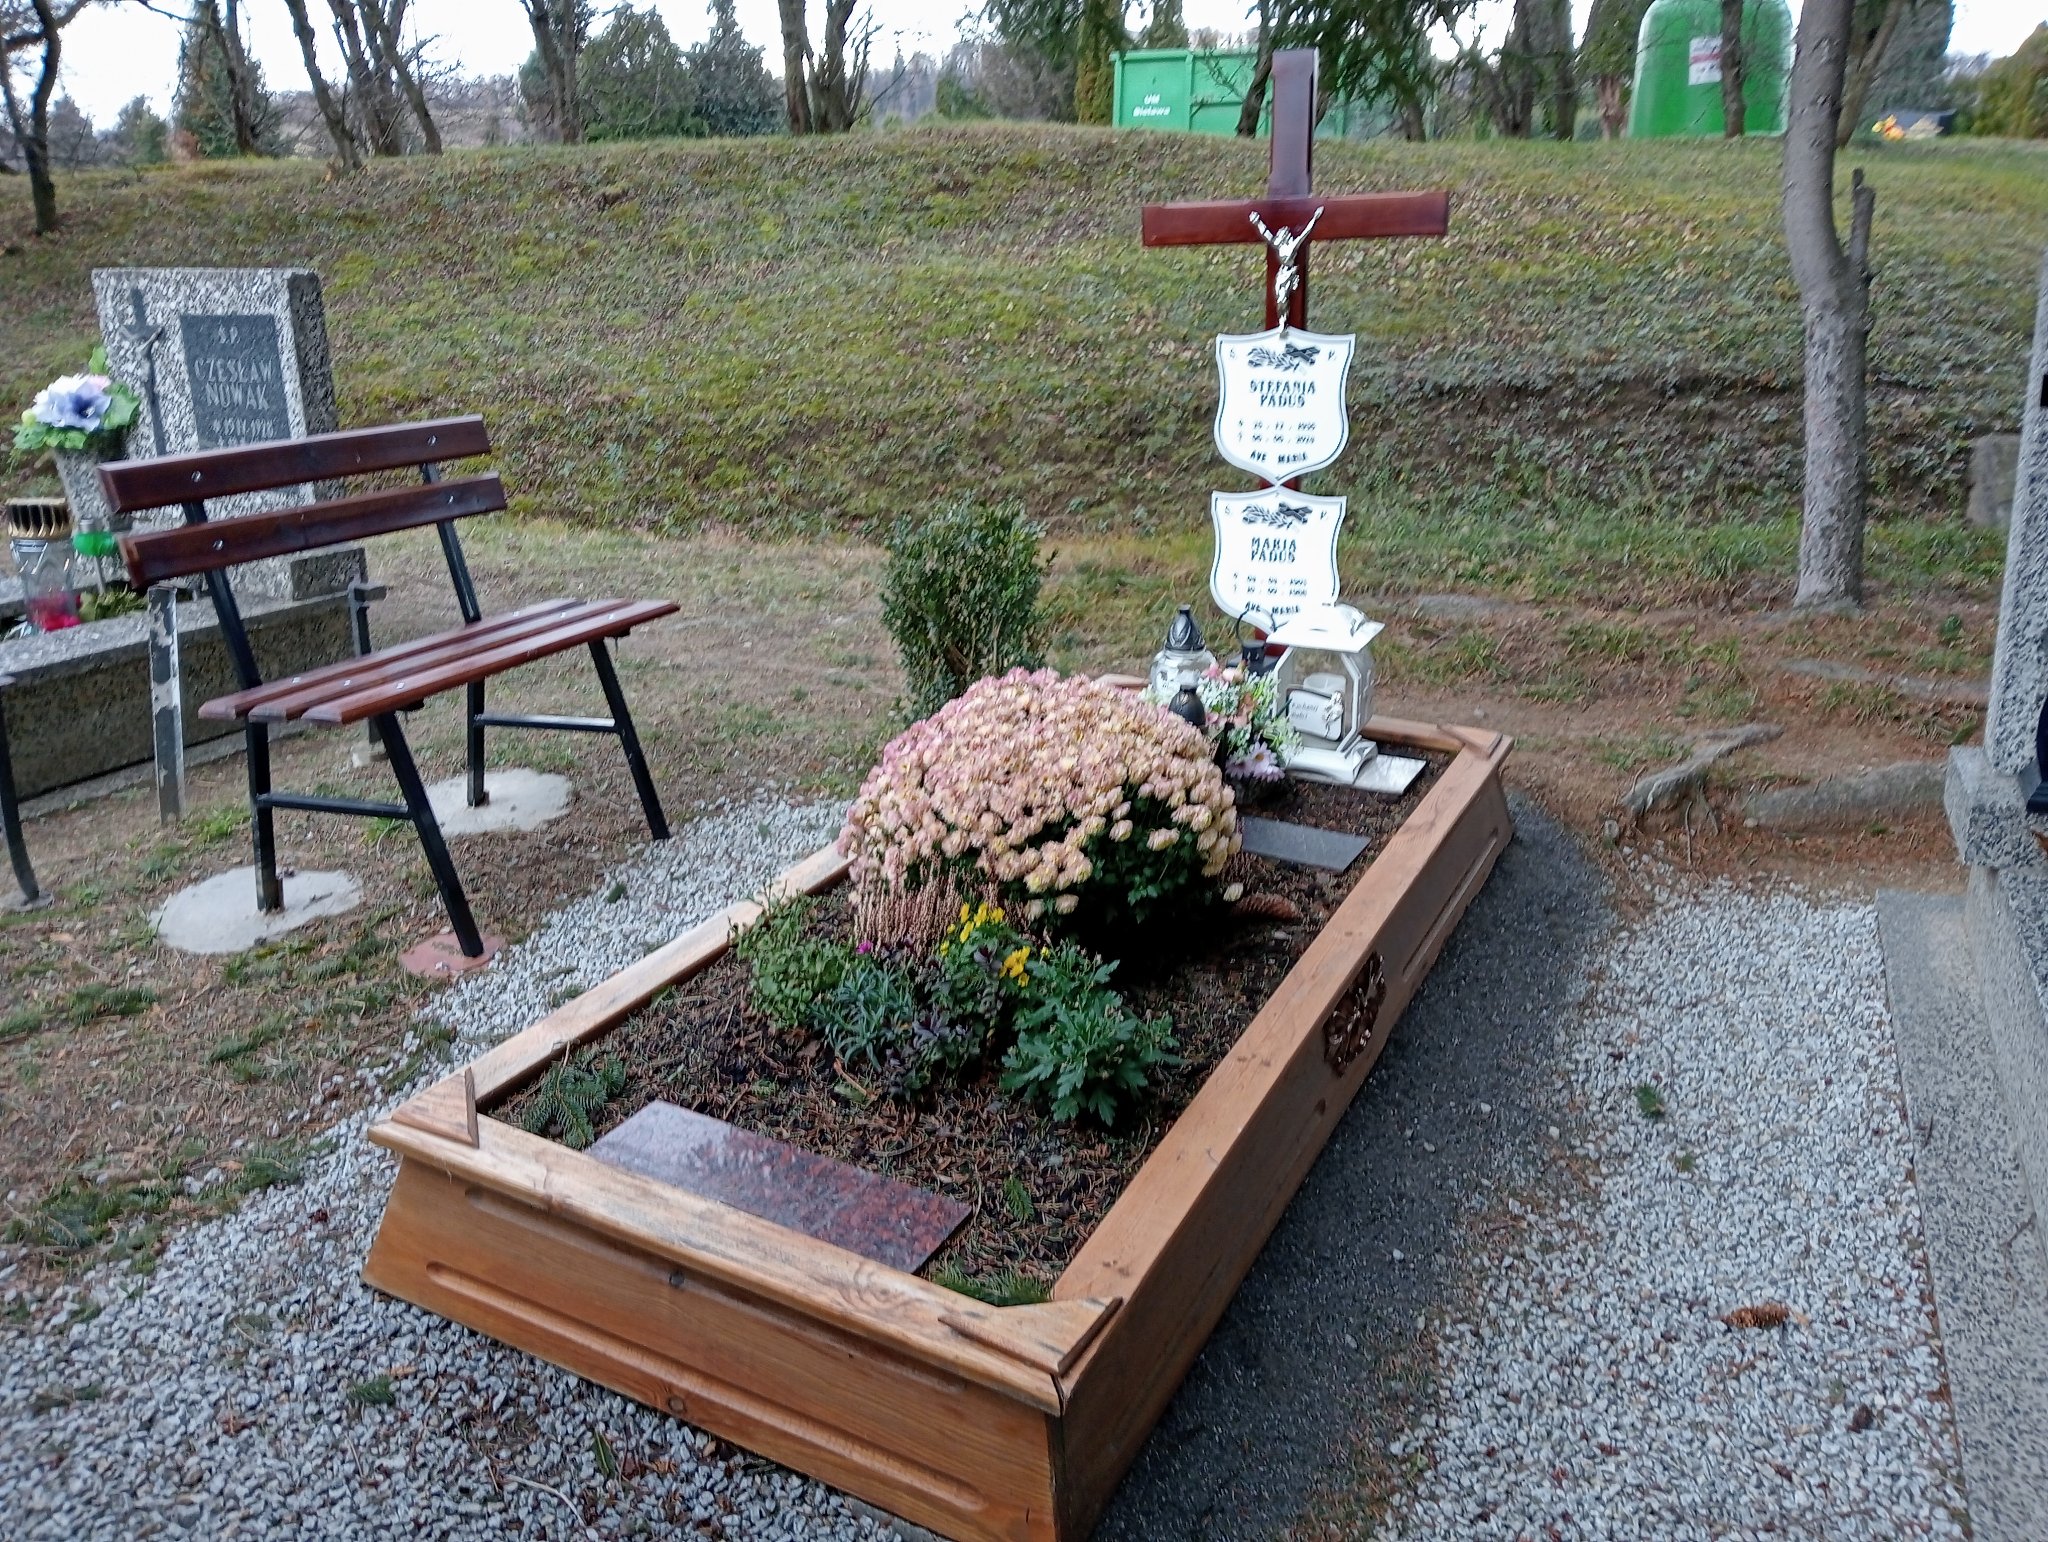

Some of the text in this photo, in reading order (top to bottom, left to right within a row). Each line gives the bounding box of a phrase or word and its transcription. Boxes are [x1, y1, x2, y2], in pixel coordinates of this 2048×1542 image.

[194, 357, 273, 383] CZESŁAW
[205, 382, 270, 410] NOWAK
[1251, 537, 1297, 552] MARIA
